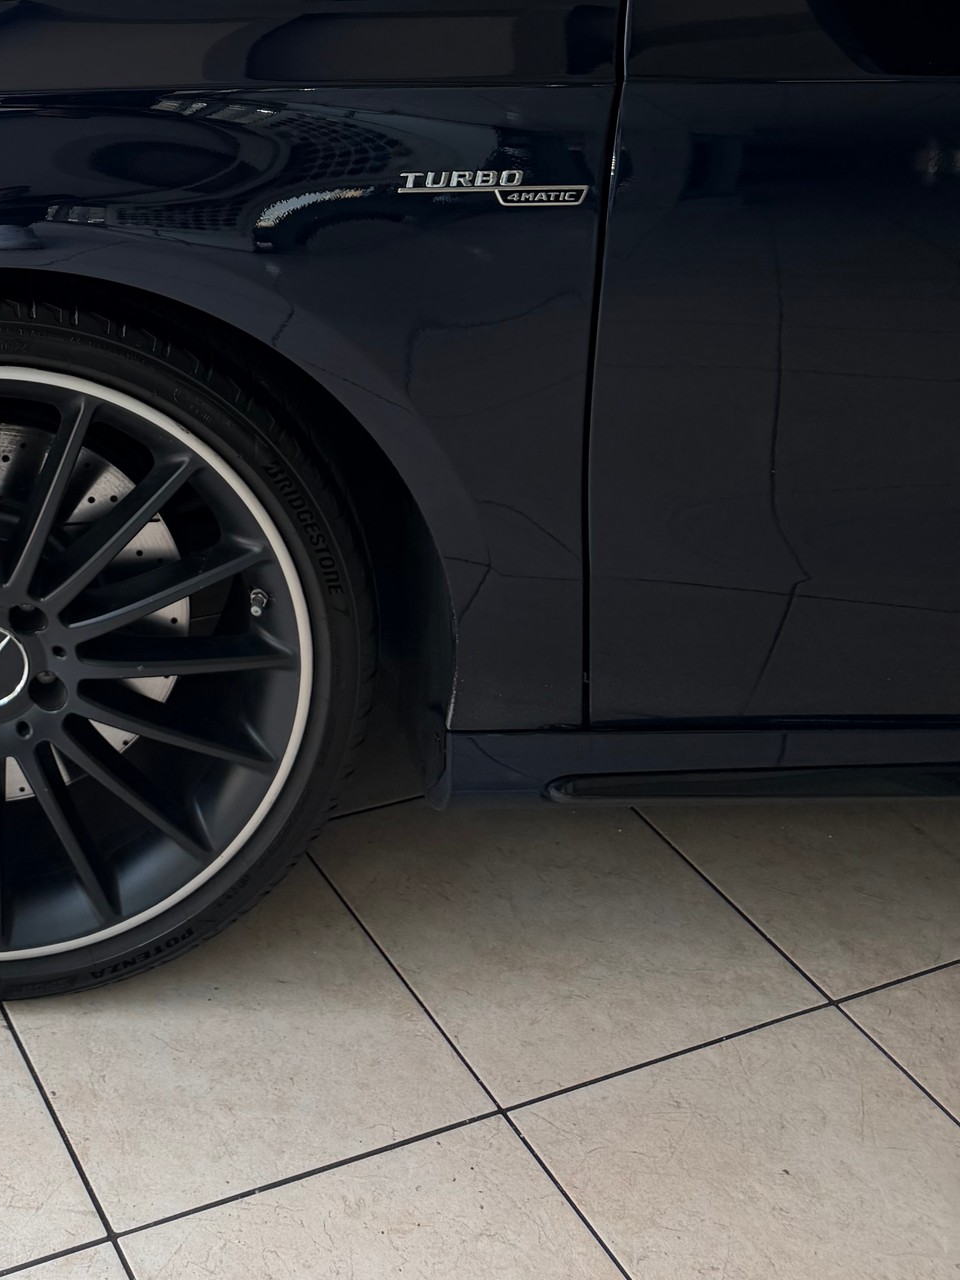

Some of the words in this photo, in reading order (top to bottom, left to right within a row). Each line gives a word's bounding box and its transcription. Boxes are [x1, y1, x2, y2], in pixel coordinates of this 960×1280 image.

[399, 170, 524, 188] TURBO
[507, 191, 578, 202] 4MATIC
[262, 460, 344, 595] BRIDGESTONE
[90, 927, 195, 980] POTENZA
